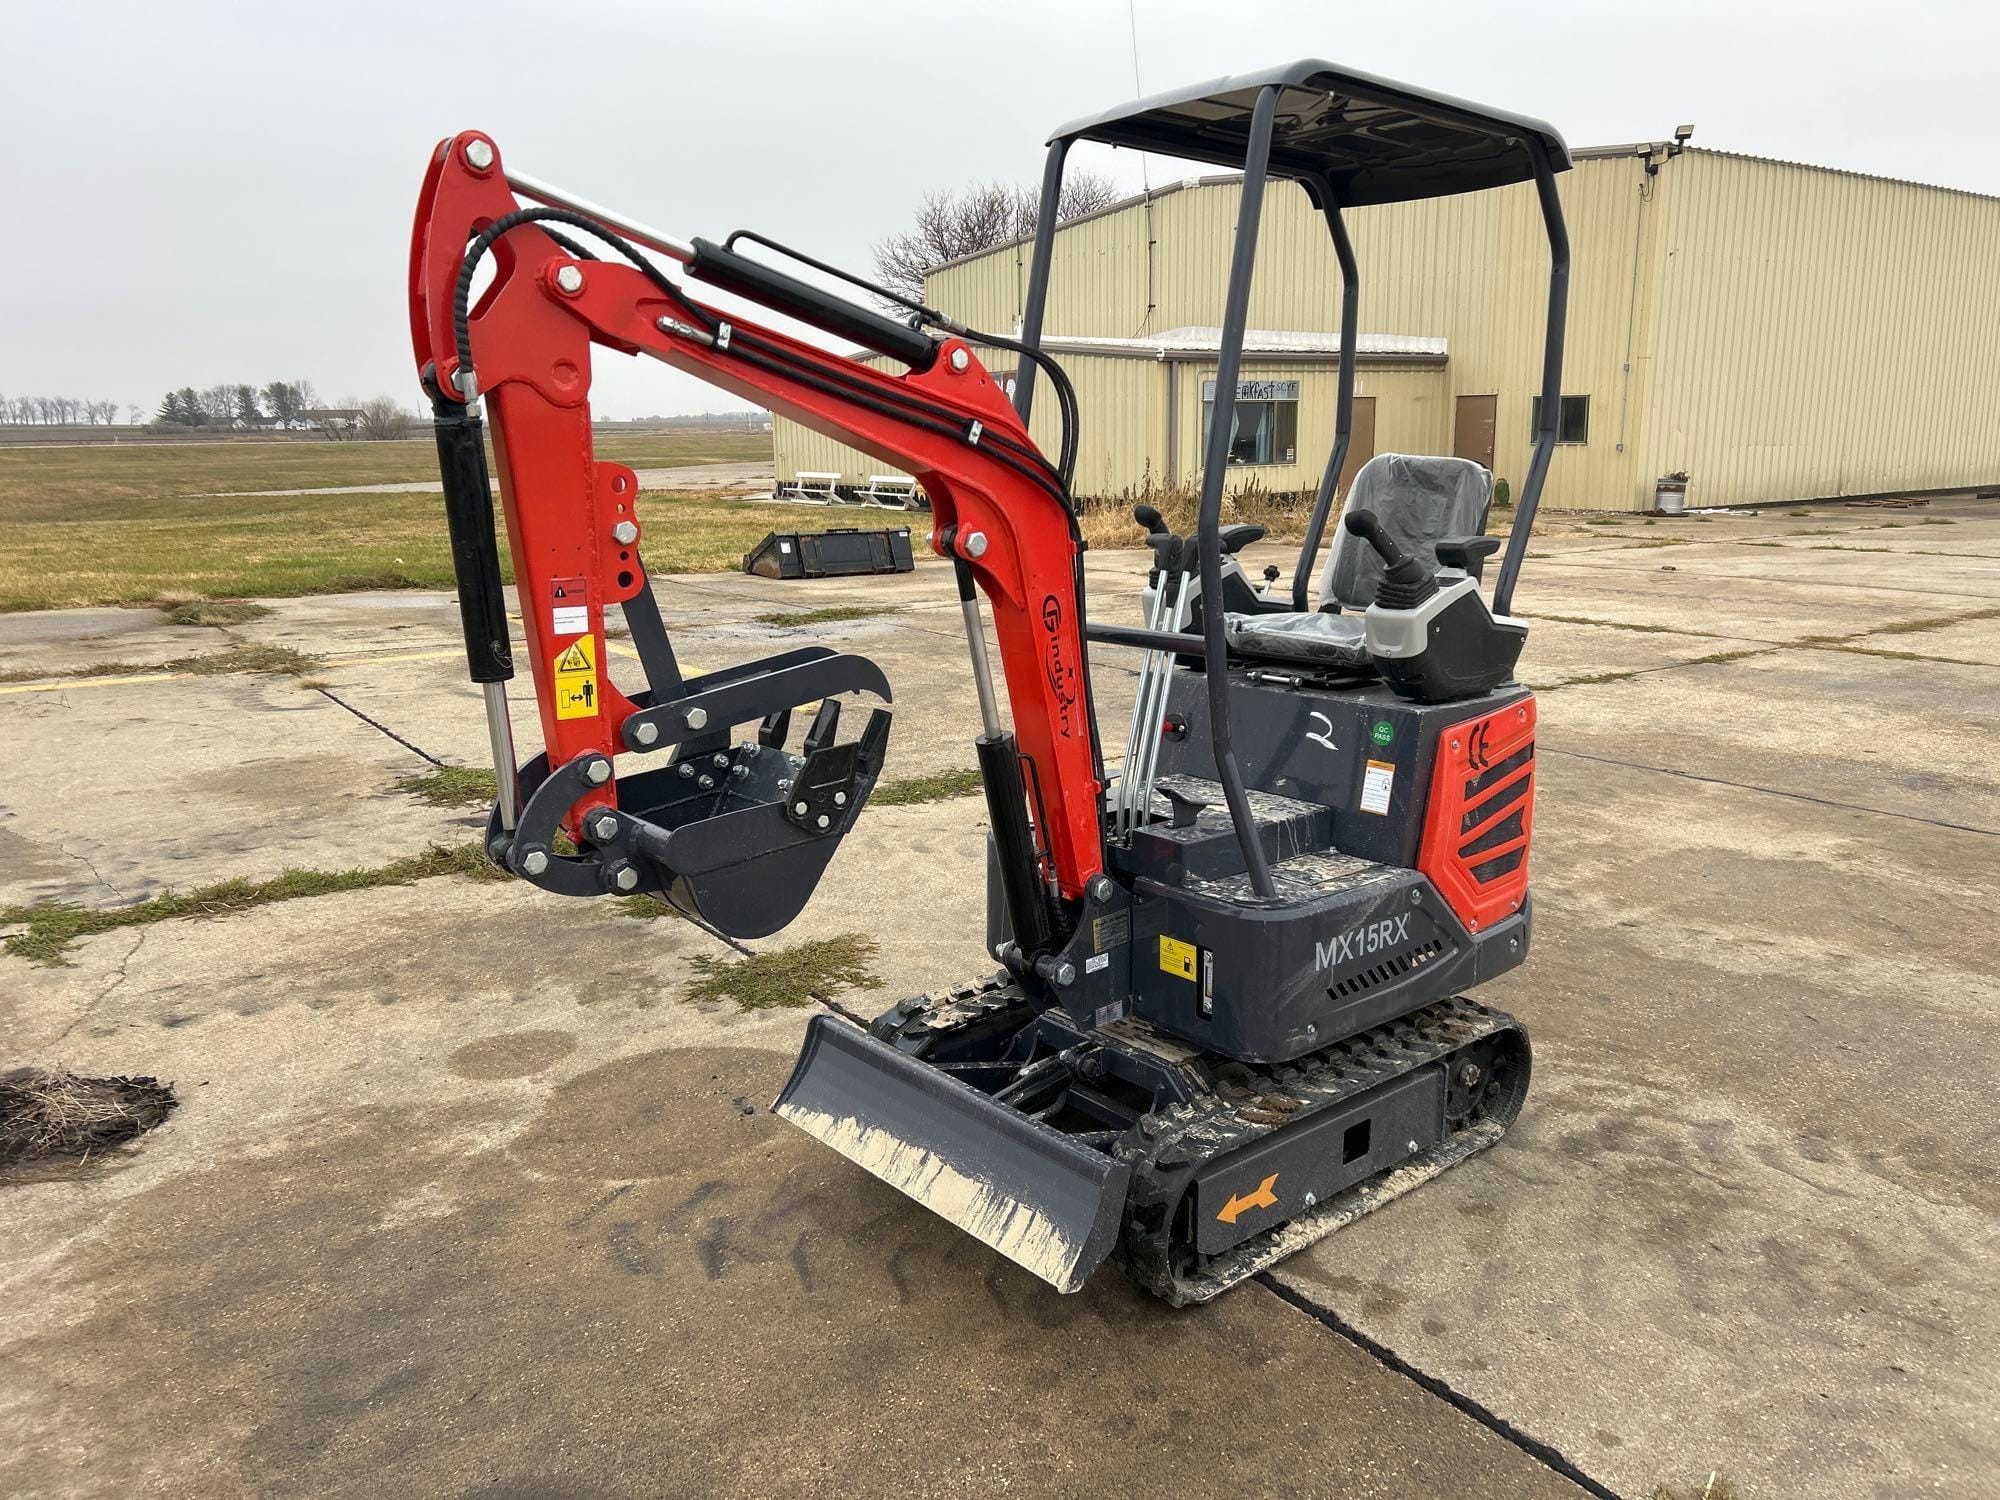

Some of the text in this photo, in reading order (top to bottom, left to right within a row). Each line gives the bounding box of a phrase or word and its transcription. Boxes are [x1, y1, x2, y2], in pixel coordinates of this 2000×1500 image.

[1305, 711, 1340, 751] 2
[1373, 732, 1391, 742] PASS
[1378, 726, 1389, 734] QC
[1468, 720, 1491, 771] CE
[1315, 912, 1410, 972] MX15RX
